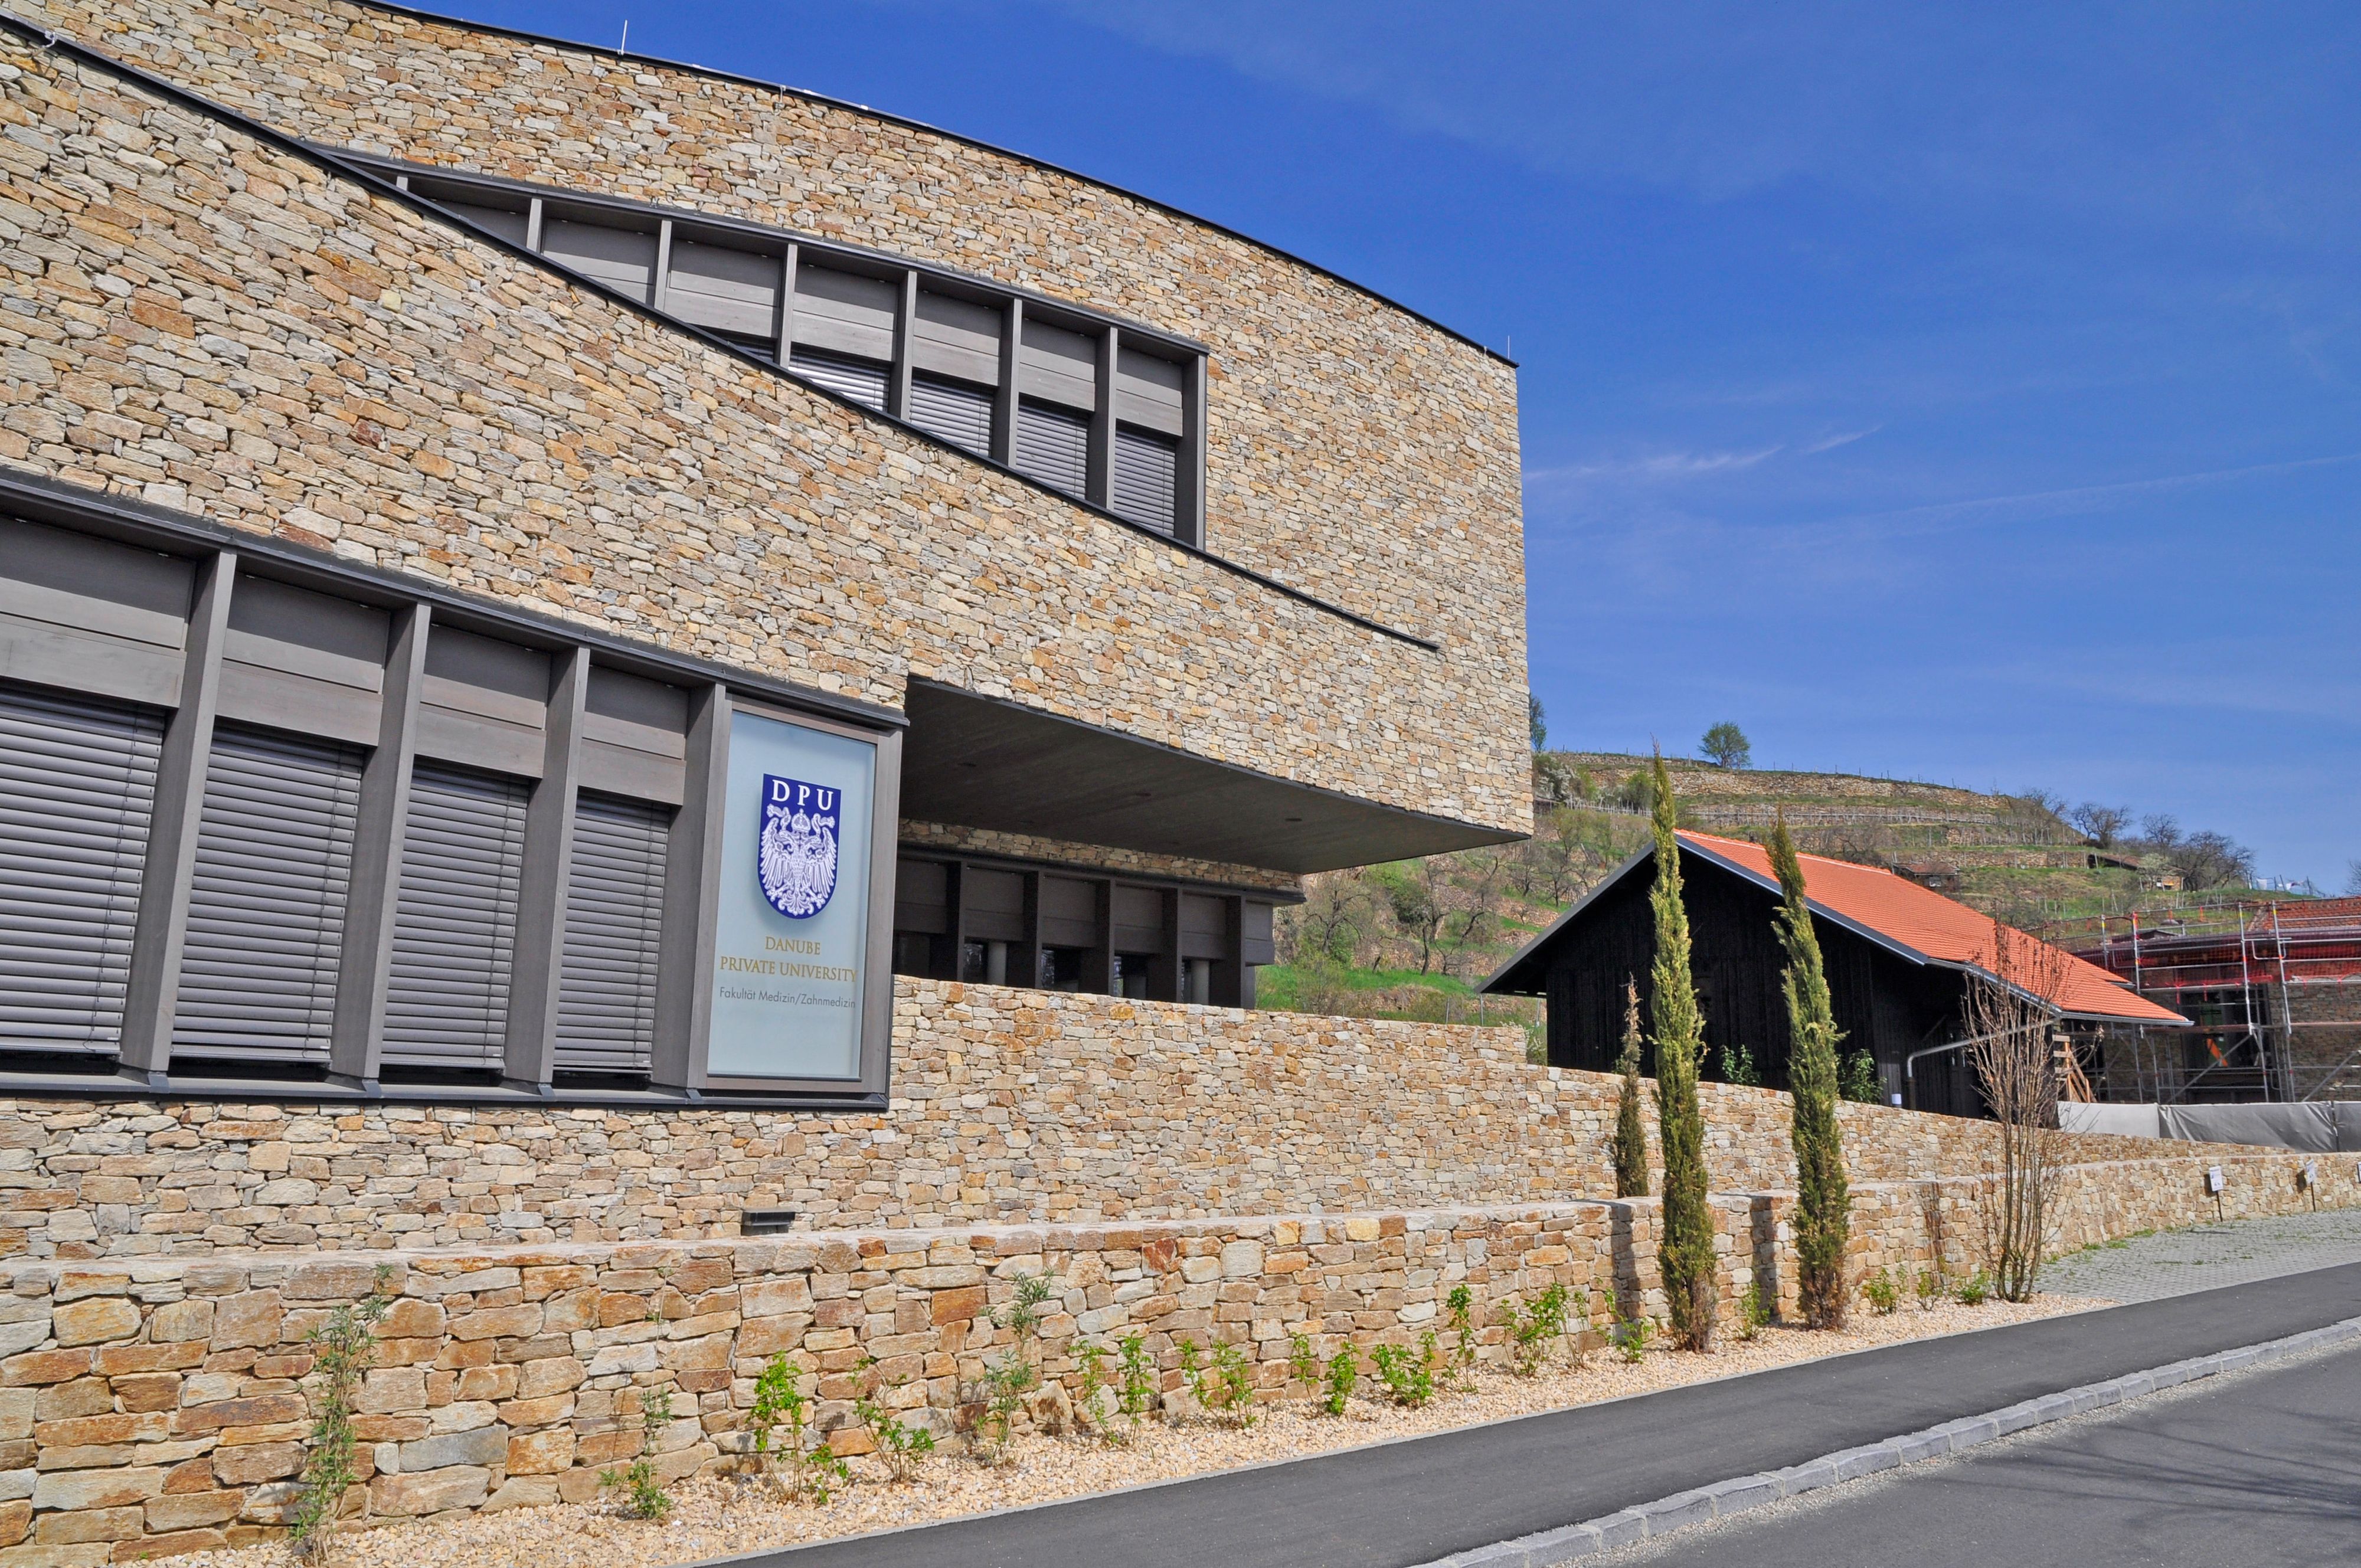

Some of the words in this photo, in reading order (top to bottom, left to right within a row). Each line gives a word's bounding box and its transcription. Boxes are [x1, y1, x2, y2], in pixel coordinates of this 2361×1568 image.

[771, 779, 833, 810] DPU
[765, 936, 820, 955] DANUBE
[720, 956, 775, 974] PRIVATE
[780, 962, 858, 982] UNIVERSITY
[720, 987, 756, 1000] Fakultät
[758, 990, 855, 1008] Medizin/Zahnmedizin
